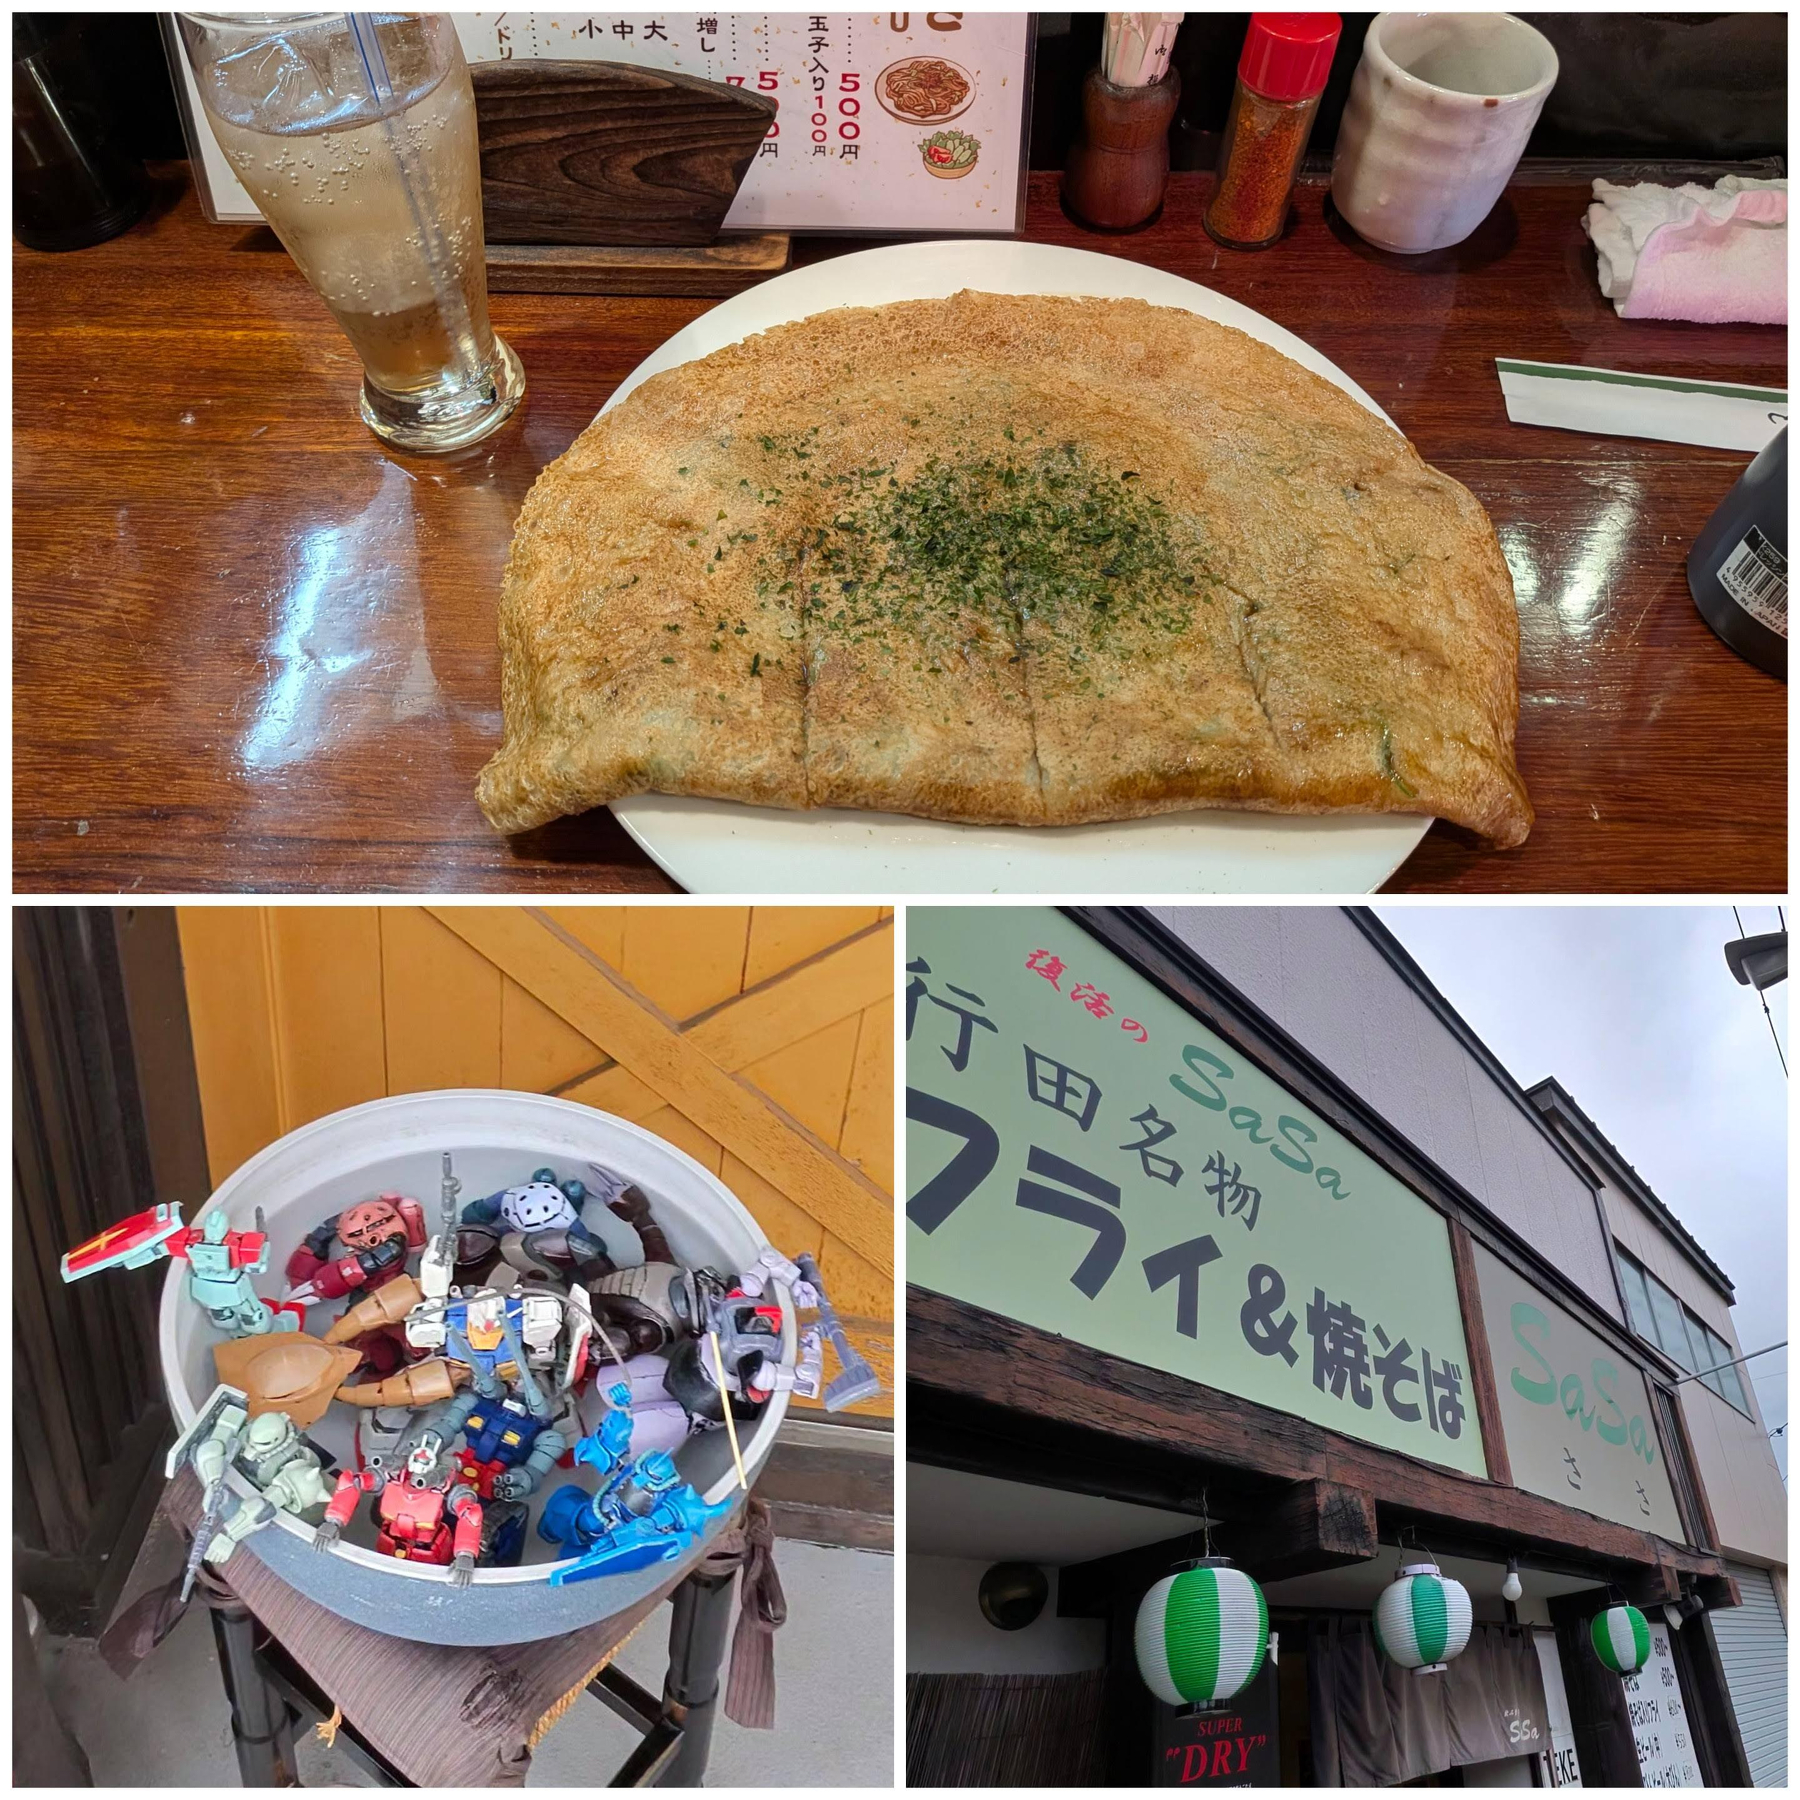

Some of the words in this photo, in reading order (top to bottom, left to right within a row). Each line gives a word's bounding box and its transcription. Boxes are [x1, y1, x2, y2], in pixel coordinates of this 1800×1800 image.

[838, 73, 860, 159] 500円
[1721, 573, 1739, 596] MADE
[1740, 596, 1749, 606] IN
[1750, 608, 1781, 630] APAN
[906, 956, 1262, 1232] 行田名物
[1024, 949, 1148, 1043] 復活の
[1169, 1044, 1351, 1200] SaSa
[1510, 1302, 1655, 1466] SaSa
[1198, 1717, 1243, 1737] SUPER
